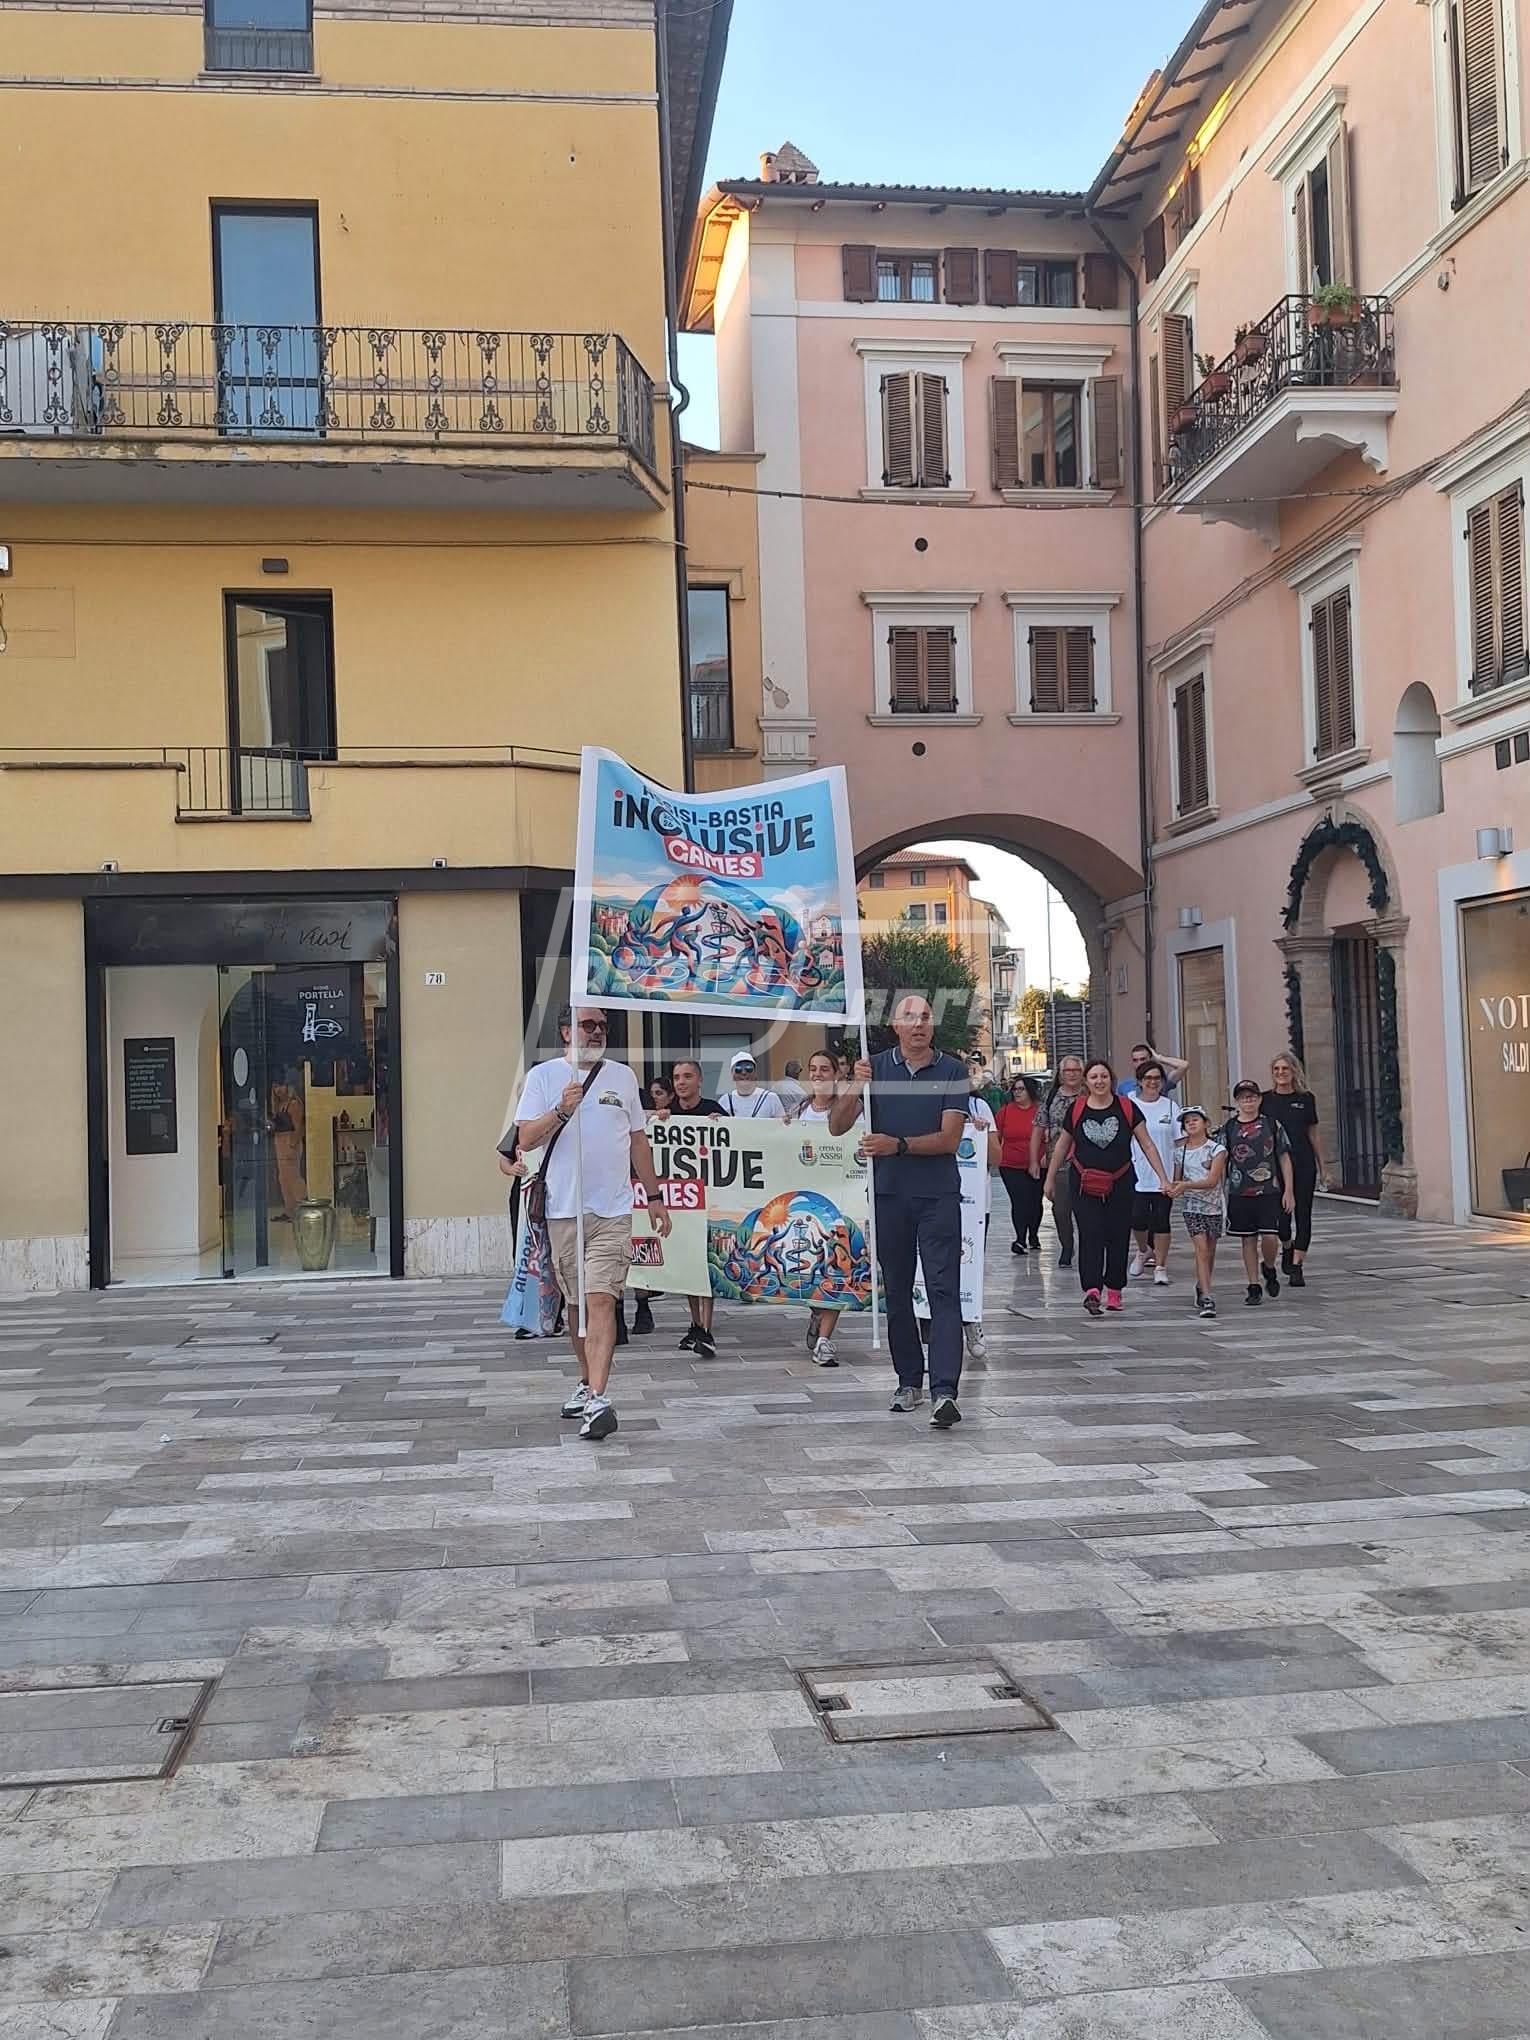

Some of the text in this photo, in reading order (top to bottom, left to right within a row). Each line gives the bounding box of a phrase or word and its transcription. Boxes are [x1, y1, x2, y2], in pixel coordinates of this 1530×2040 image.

[667, 839, 756, 877] GAMES
[299, 990, 344, 1000] PORTELLA
[1503, 1042, 1529, 1073] SALDI
